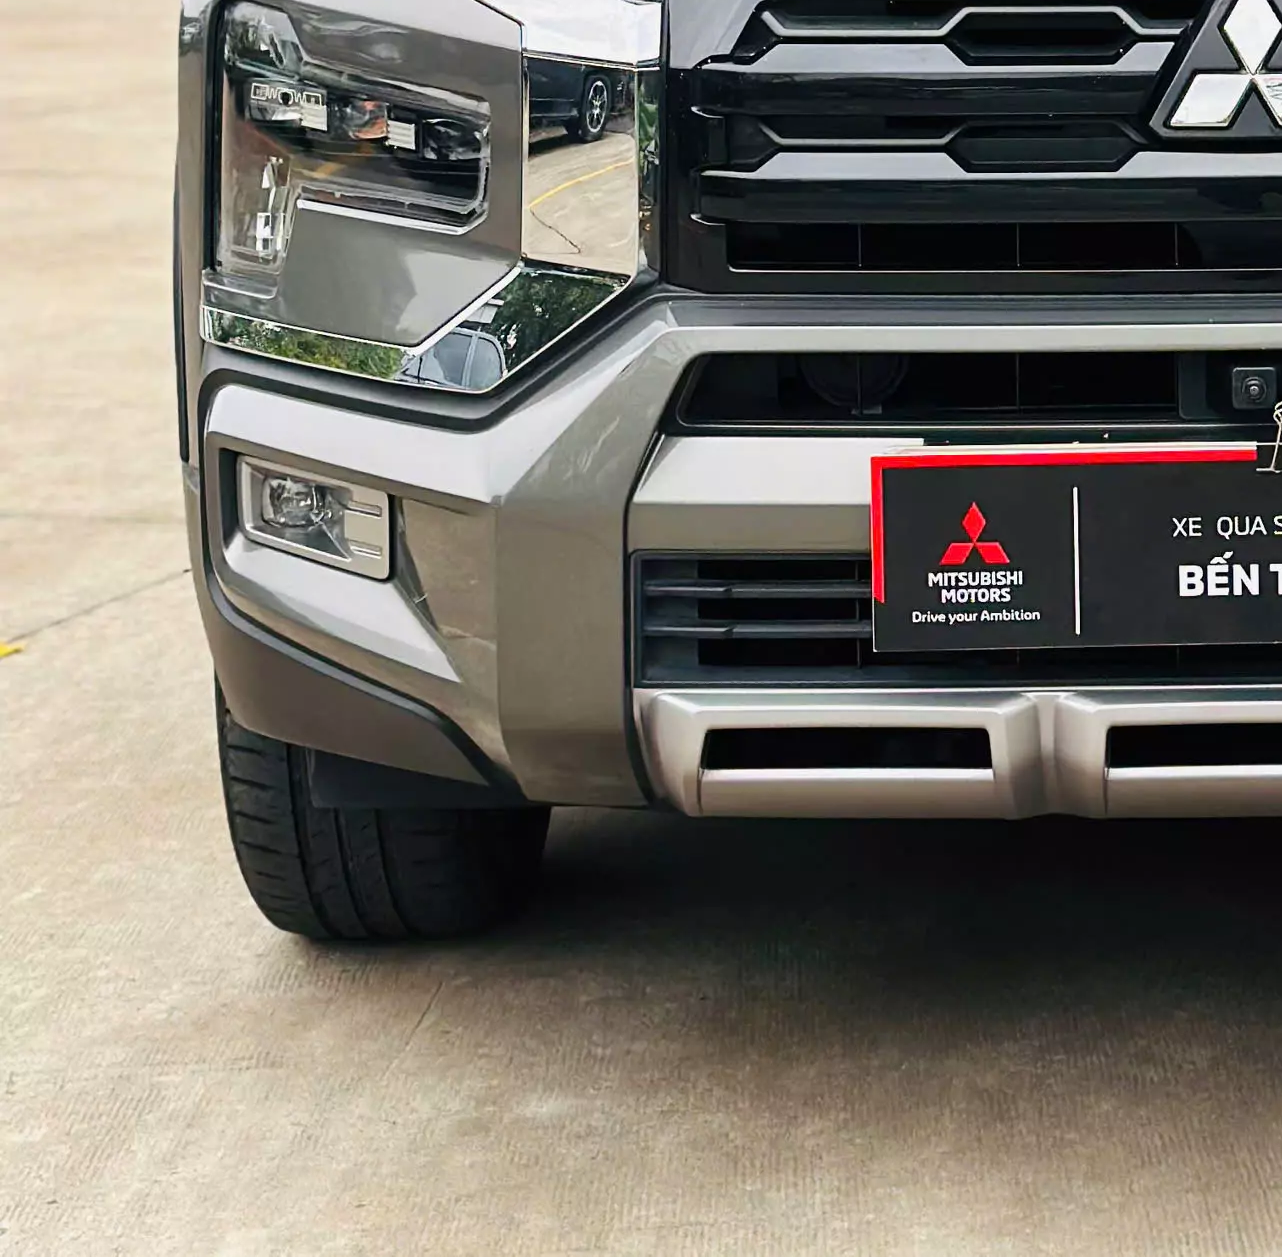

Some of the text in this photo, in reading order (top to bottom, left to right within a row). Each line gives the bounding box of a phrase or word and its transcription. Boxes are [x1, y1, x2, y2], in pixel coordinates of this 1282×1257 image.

[1172, 516, 1203, 538] XE
[1216, 515, 1268, 540] QUA
[927, 570, 1023, 587] MITSUBISHI
[1178, 550, 1260, 597] BẾN
[941, 588, 1011, 603] MOTORS
[911, 608, 1041, 625] Drive your Ambition
